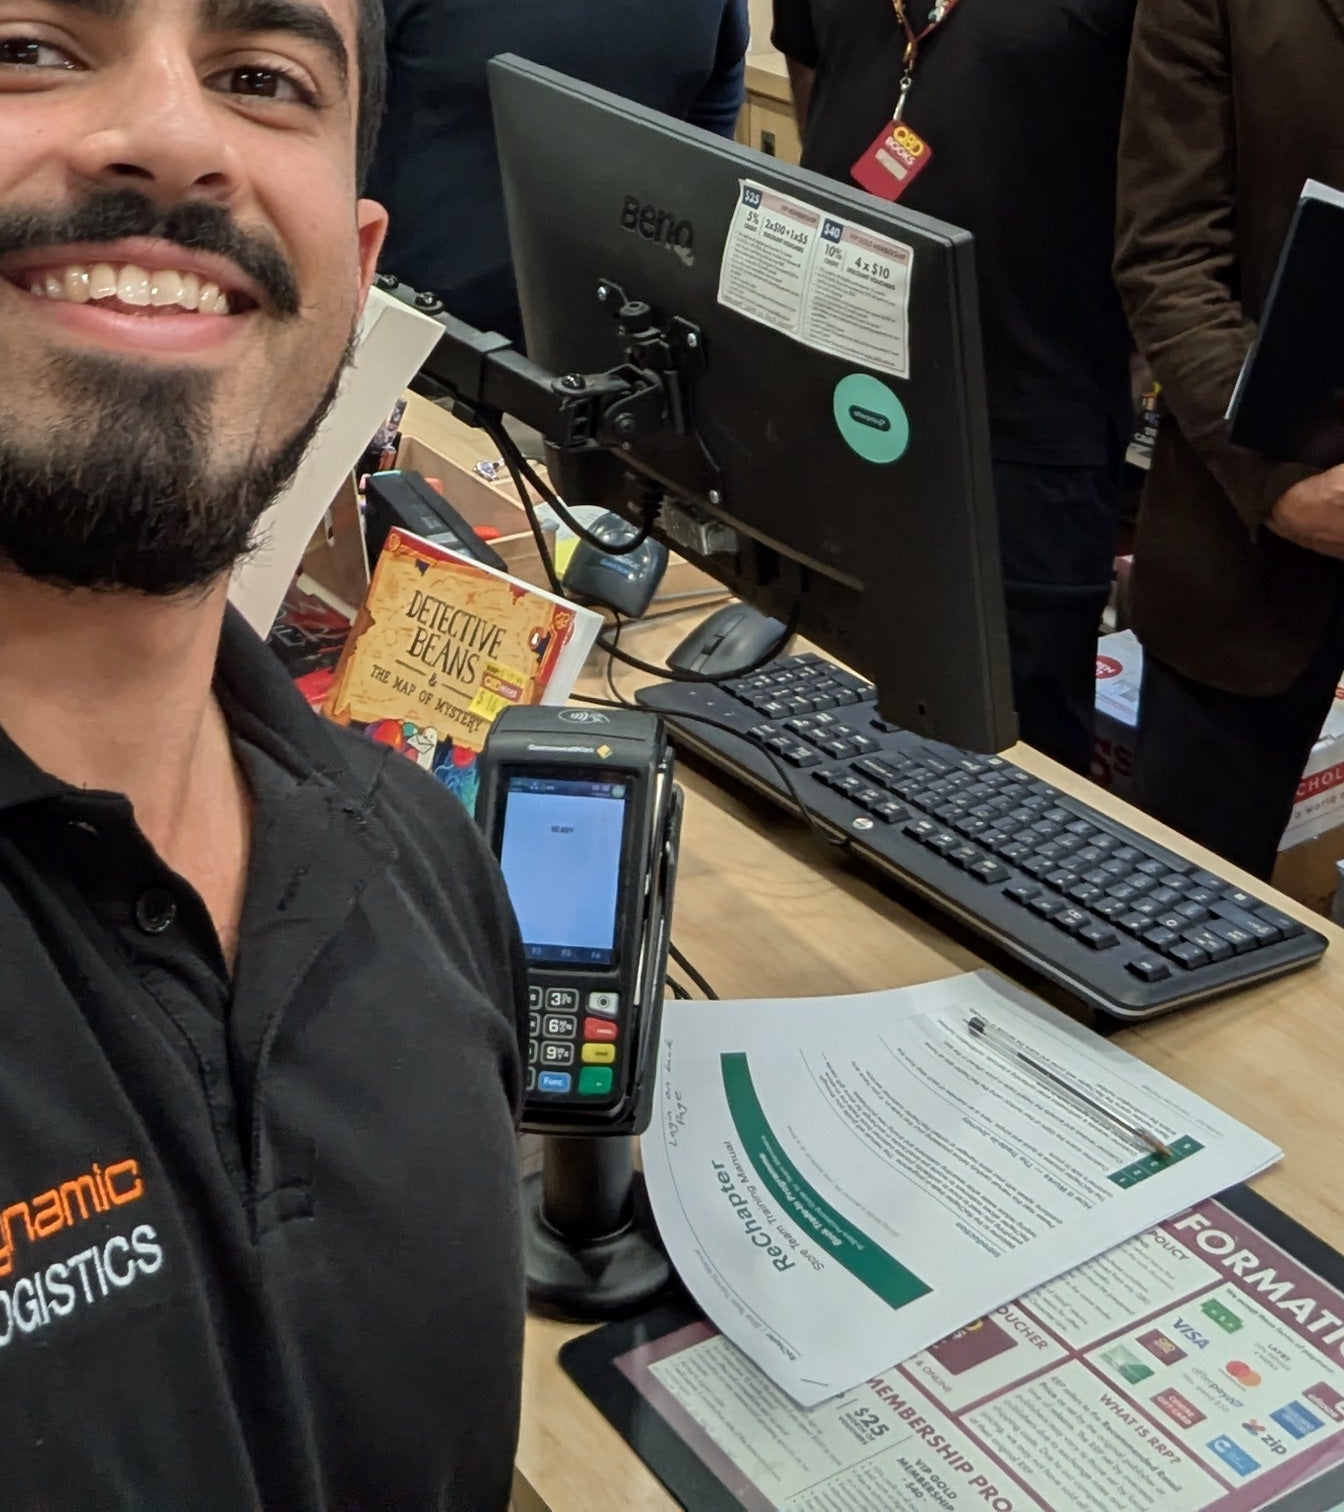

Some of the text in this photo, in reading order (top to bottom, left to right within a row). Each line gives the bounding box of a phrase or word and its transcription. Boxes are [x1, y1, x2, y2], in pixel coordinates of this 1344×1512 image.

[885, 136, 916, 166] BOOKS
[893, 125, 923, 157] QBD
[745, 188, 760, 204] $25
[620, 195, 696, 267] BenQ
[747, 210, 760, 225] 5%
[824, 222, 841, 239] $40
[825, 244, 843, 261] 10%
[855, 257, 862, 269] 4
[871, 264, 890, 279] $10
[406, 589, 506, 660] DETECTIVE
[408, 626, 479, 685] BEANS
[428, 672, 438, 687] &
[370, 664, 484, 733] THE MAP OF MYSTERY
[1306, 795, 1336, 813] world
[551, 992, 563, 1006] 3
[548, 1019, 559, 1034] 6
[546, 1046, 557, 1060] 9
[543, 1076, 564, 1088] Func
[711, 1159, 796, 1272] ReChapter
[723, 1141, 824, 1271] Store Team Training Manual
[1146, 1229, 1190, 1261] POLICY
[996, 1304, 1049, 1351] OUCHER
[1172, 1316, 1210, 1350] VISA
[923, 1365, 954, 1394] ONLINE
[855, 1406, 890, 1437] $25
[866, 1377, 974, 1473] MEMBERSHIP
[1099, 1394, 1183, 1465] WHAT IS RRP?
[1260, 1433, 1289, 1457] zip
[896, 1456, 955, 1511] MEMBERSHIP
[914, 1458, 934, 1476] VIP
[931, 1472, 958, 1500] GOLD
